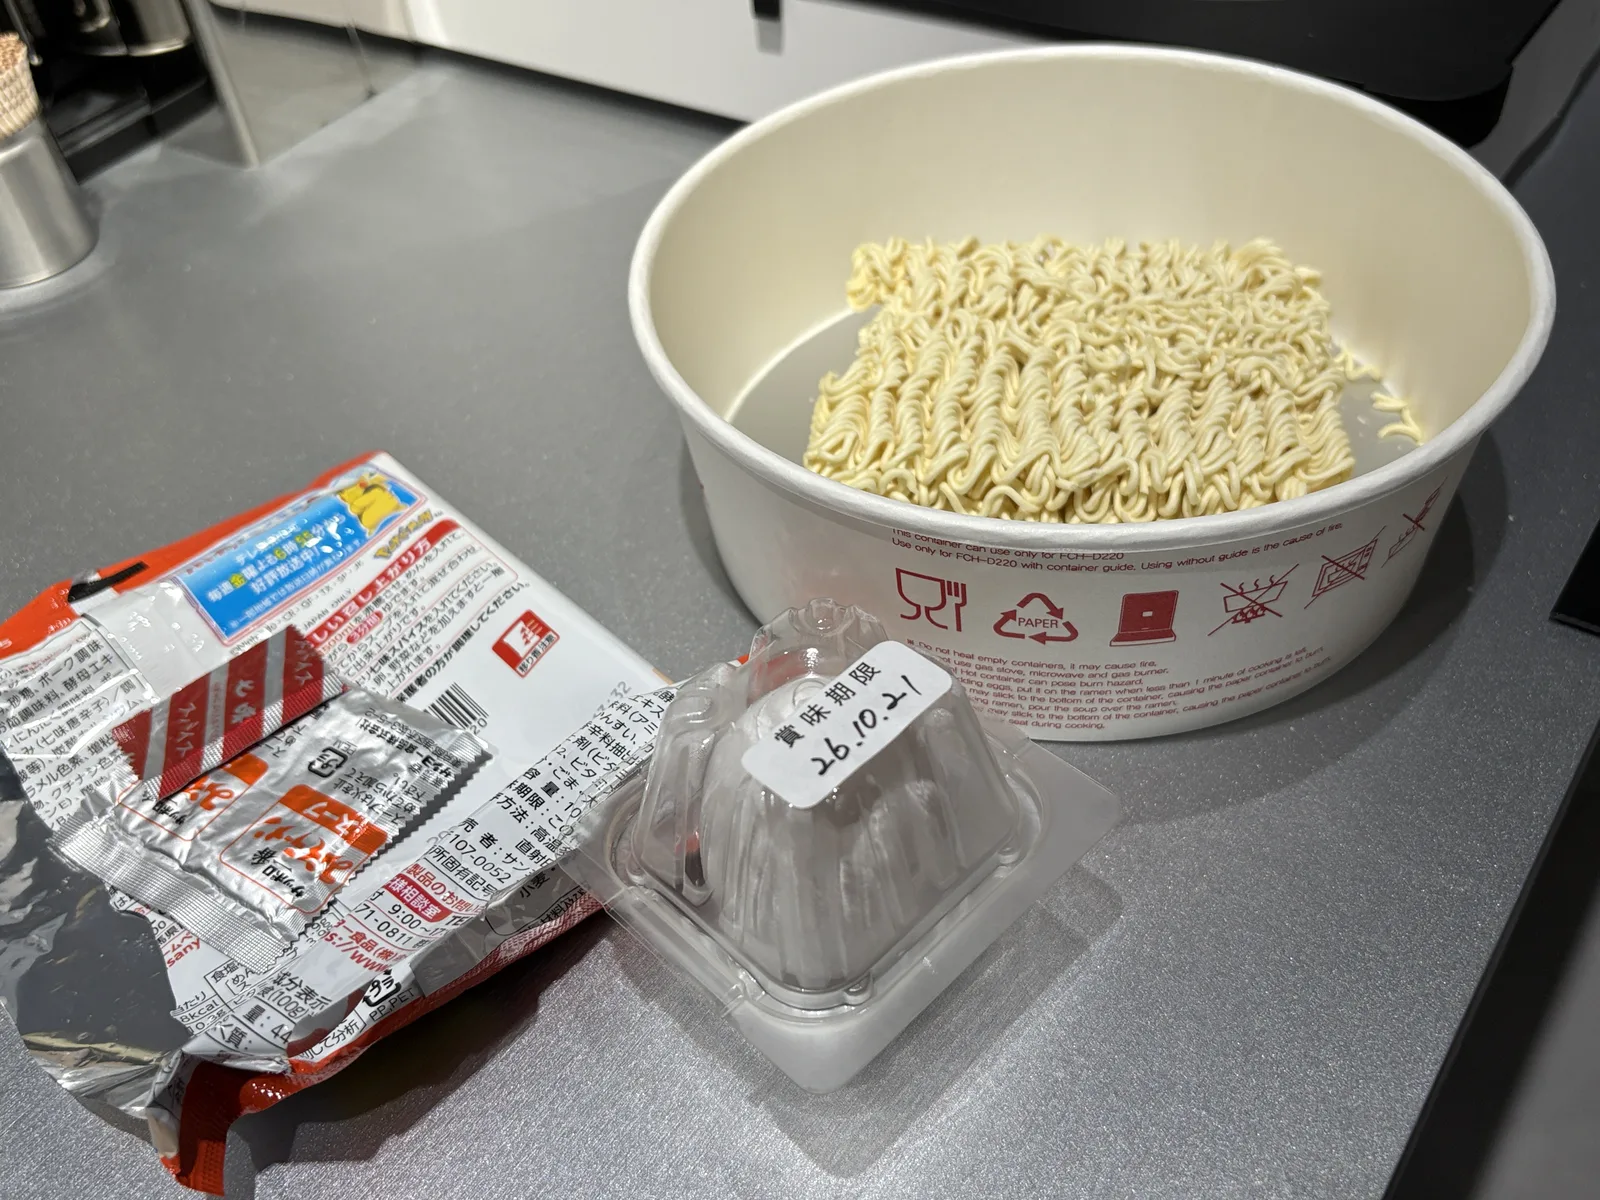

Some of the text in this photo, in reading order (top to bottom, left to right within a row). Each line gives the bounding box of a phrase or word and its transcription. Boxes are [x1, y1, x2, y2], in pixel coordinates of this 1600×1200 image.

[892, 537, 911, 549] Use
[915, 544, 936, 556] only
[939, 549, 955, 558] for
[1021, 561, 1043, 570] with
[1046, 563, 1100, 572] container
[1102, 562, 1136, 573] guide.
[1141, 560, 1173, 571] Using
[1177, 556, 1215, 567] without
[1218, 549, 1248, 562] guide
[1251, 545, 1261, 555] is
[1263, 541, 1280, 552] the
[1282, 532, 1314, 547] cause
[1316, 527, 1327, 537] of
[893, 528, 911, 539] This
[914, 533, 963, 549] container
[966, 543, 987, 553] can
[990, 547, 1011, 556] use
[1014, 550, 1038, 560] only
[1041, 551, 1057, 559] for
[306, 536, 433, 646] しい召し上がり方
[1017, 617, 1059, 629] PAPER
[774, 662, 881, 749] 賞味期限
[810, 675, 922, 776] 26.10.21
[443, 830, 512, 885] 107-0052
